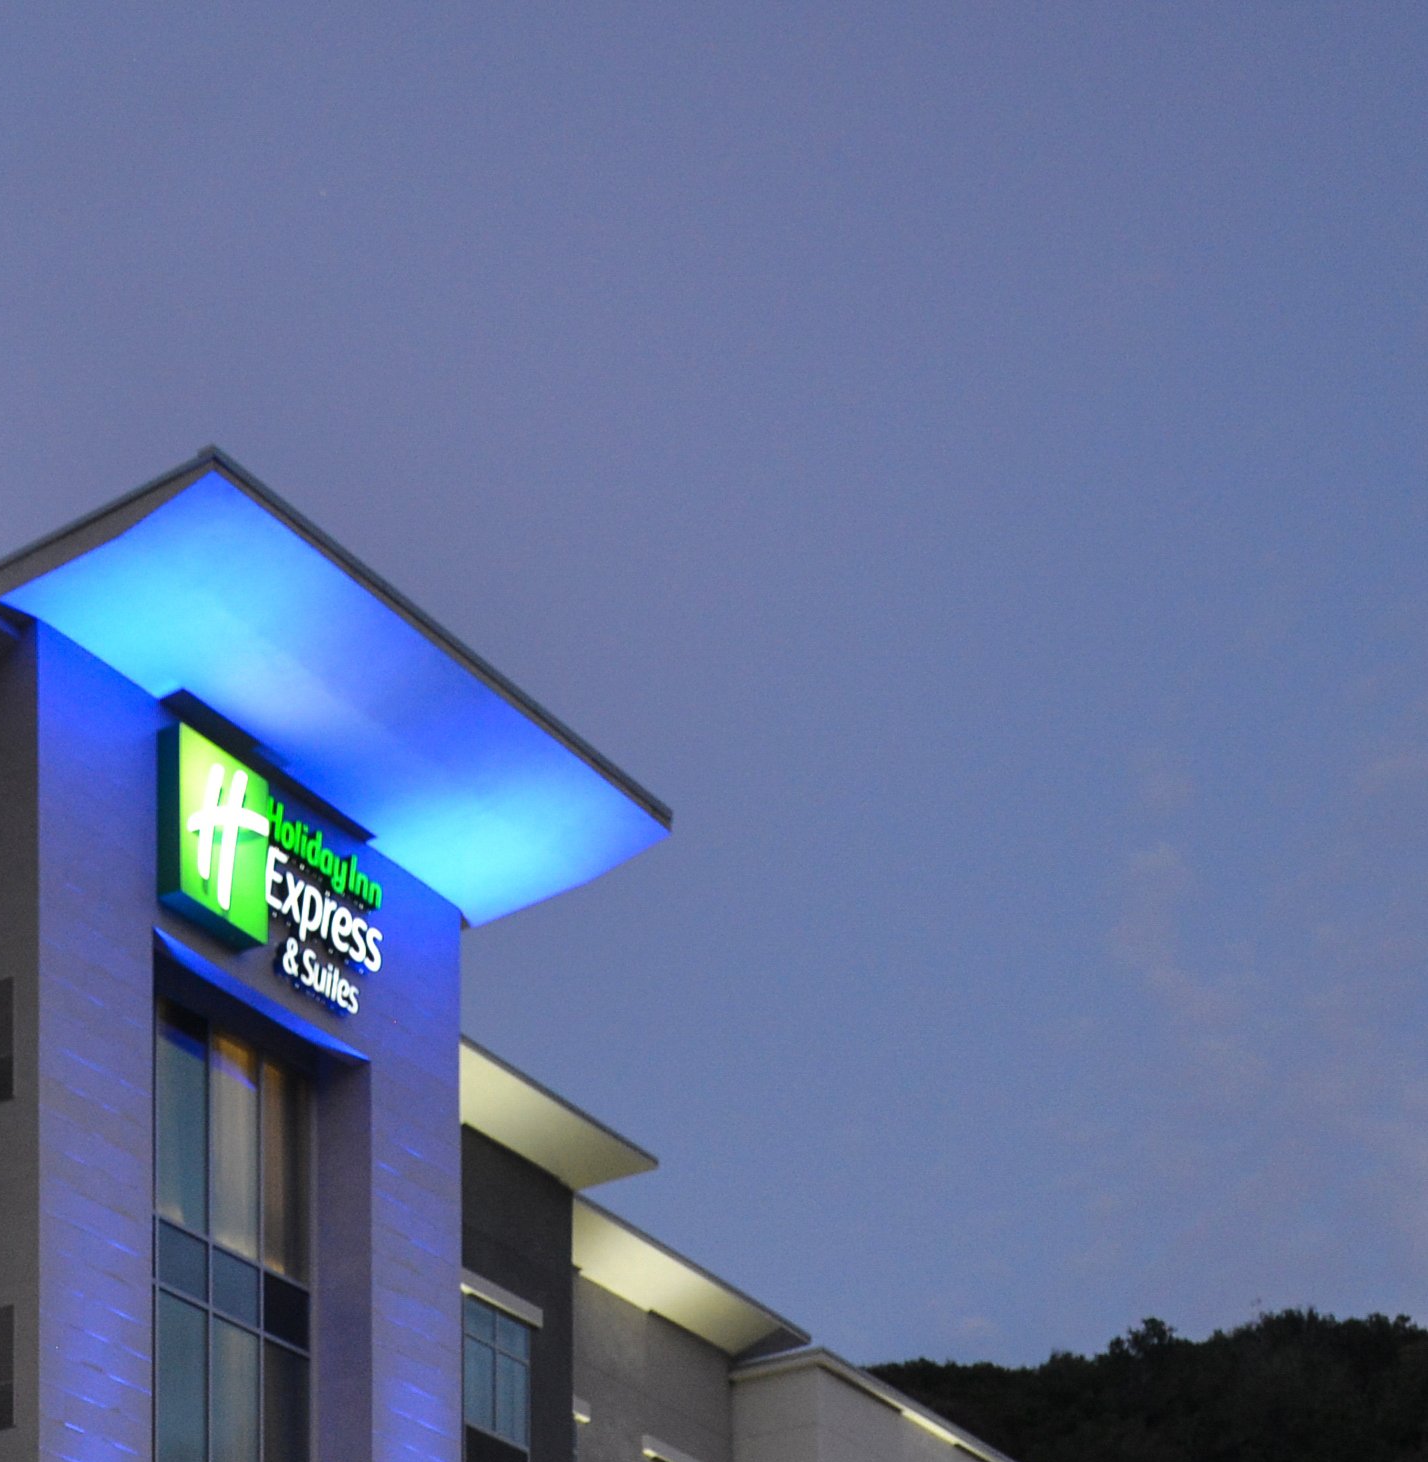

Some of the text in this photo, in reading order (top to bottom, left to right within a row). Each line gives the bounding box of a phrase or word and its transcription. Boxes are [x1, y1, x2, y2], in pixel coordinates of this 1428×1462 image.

[265, 846, 383, 972] Express
[266, 796, 383, 909] Holiday Inn
[282, 937, 359, 1014] & Suites
